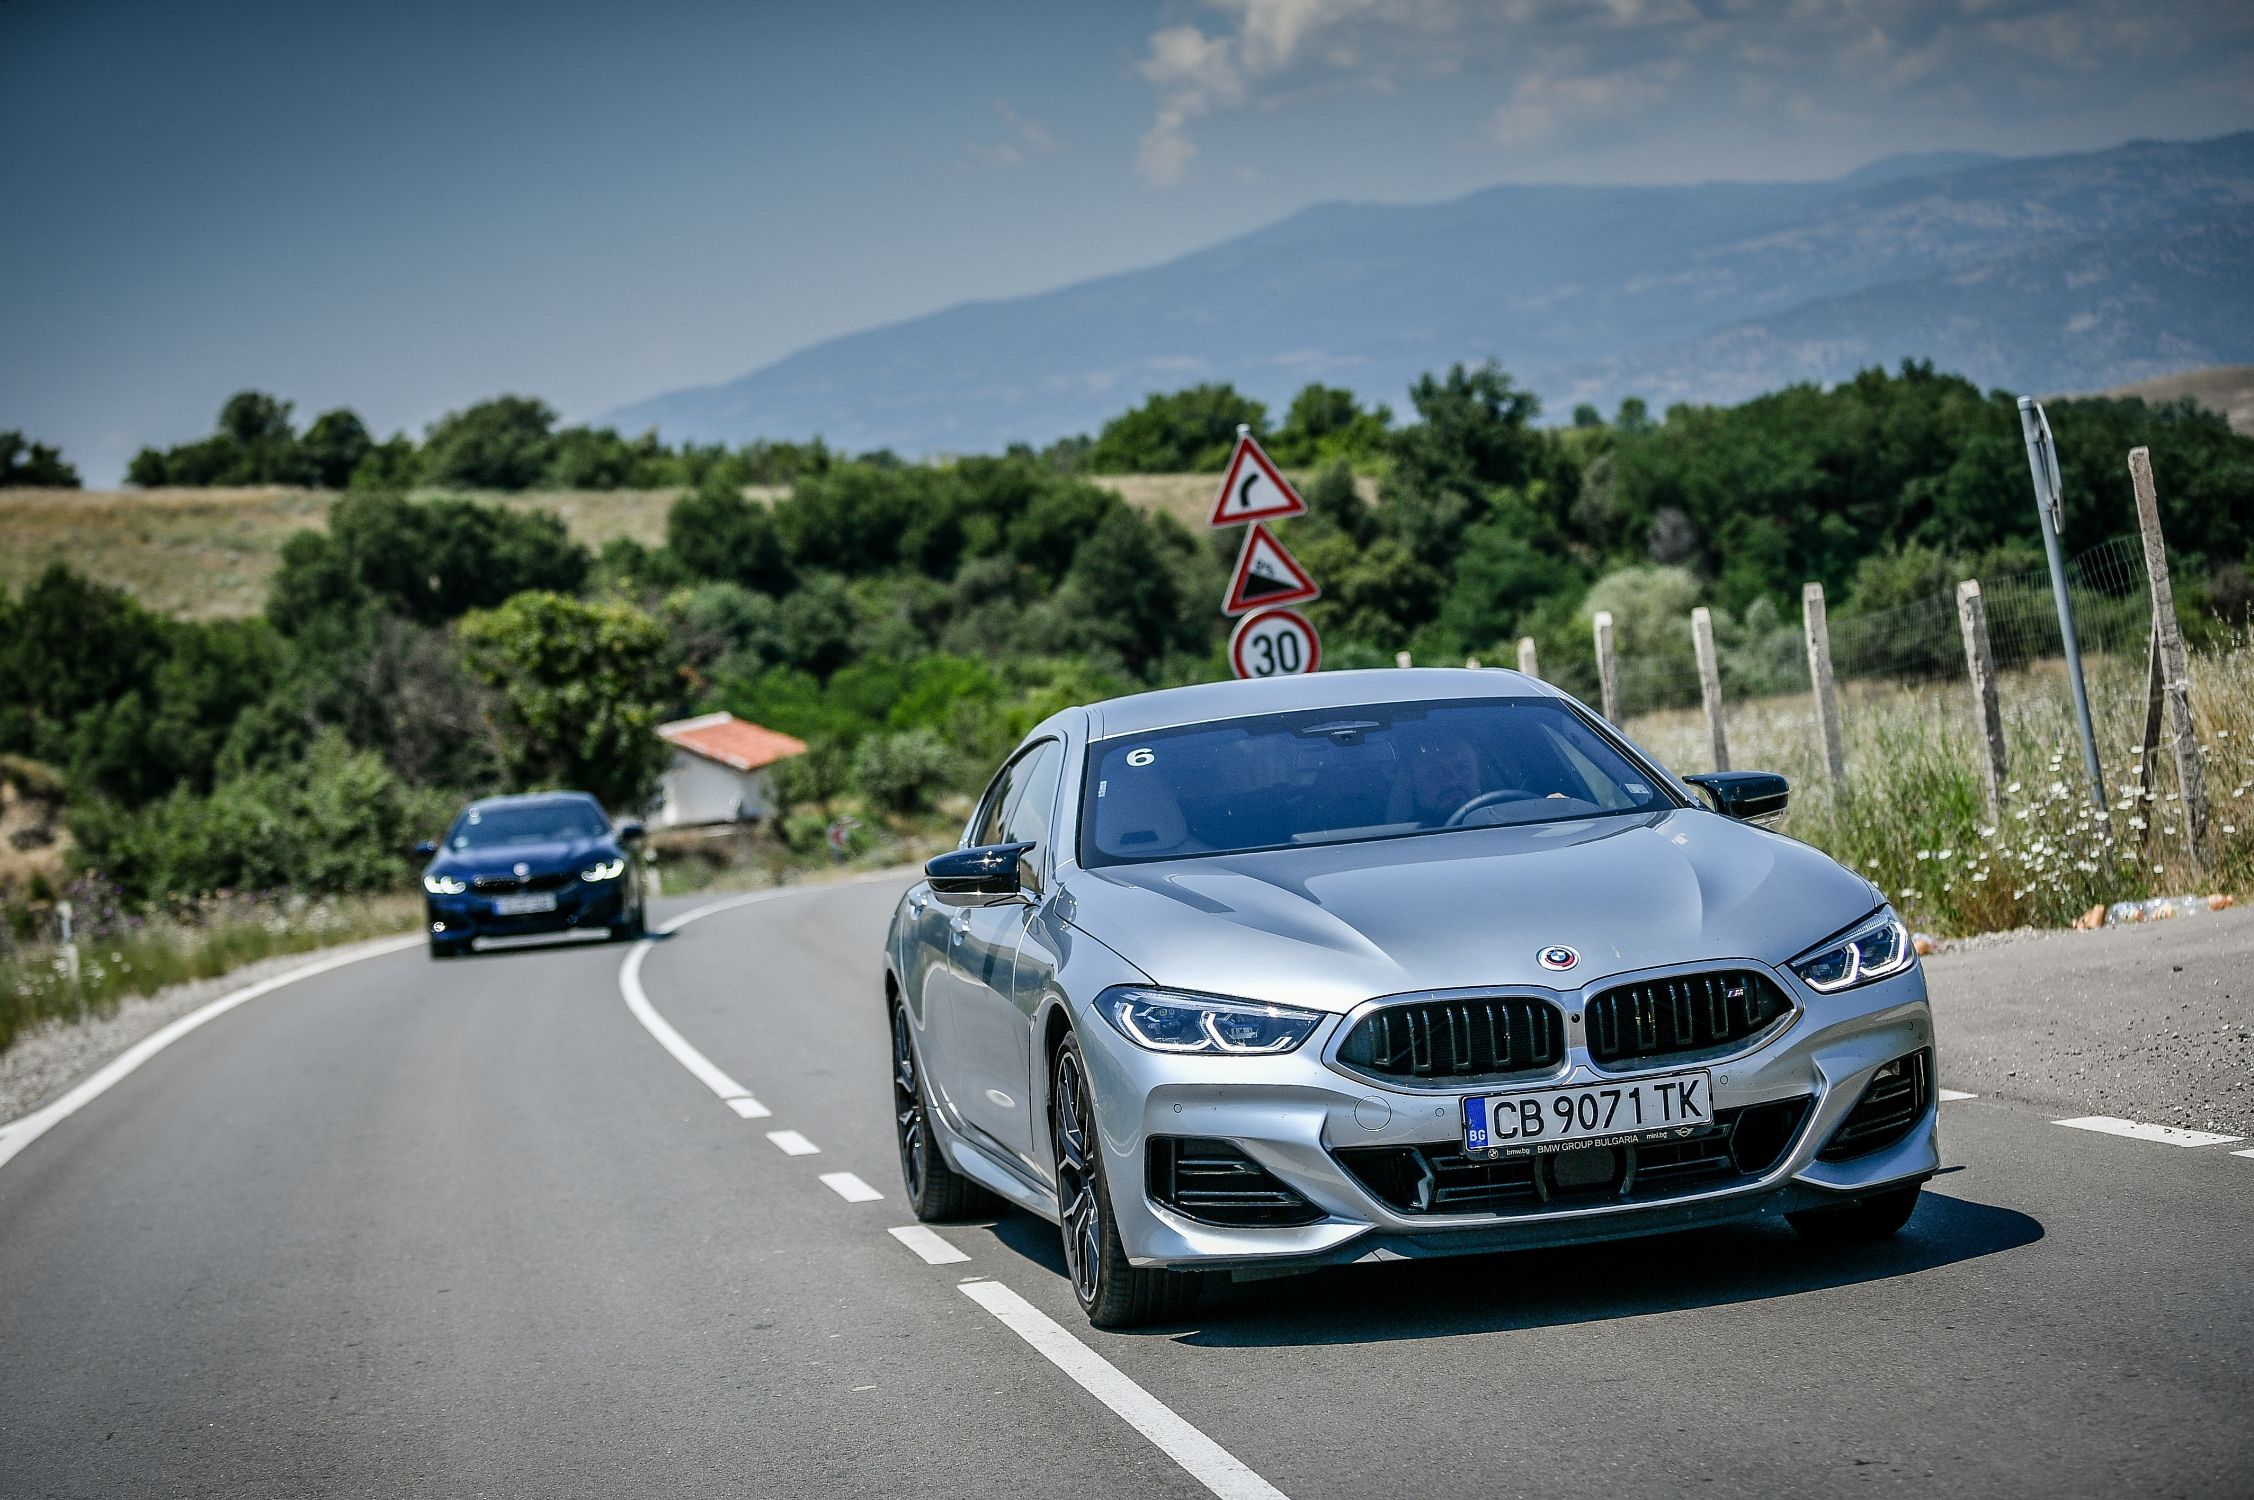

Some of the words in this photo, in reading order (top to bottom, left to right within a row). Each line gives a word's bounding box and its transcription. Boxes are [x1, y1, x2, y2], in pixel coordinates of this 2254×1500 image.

[1253, 631, 1300, 677] 30
[1126, 747, 1155, 767] 6
[1493, 1099, 1545, 1139] CB
[1552, 1087, 1642, 1134] 9071
[1654, 1079, 1702, 1121] TK
[1469, 1129, 1486, 1142] BG
[1537, 1144, 1560, 1154] BMW
[1561, 1140, 1594, 1151] GROUP
[1594, 1134, 1639, 1147] BULGARIA
[1506, 1147, 1530, 1156] bmw.bg
